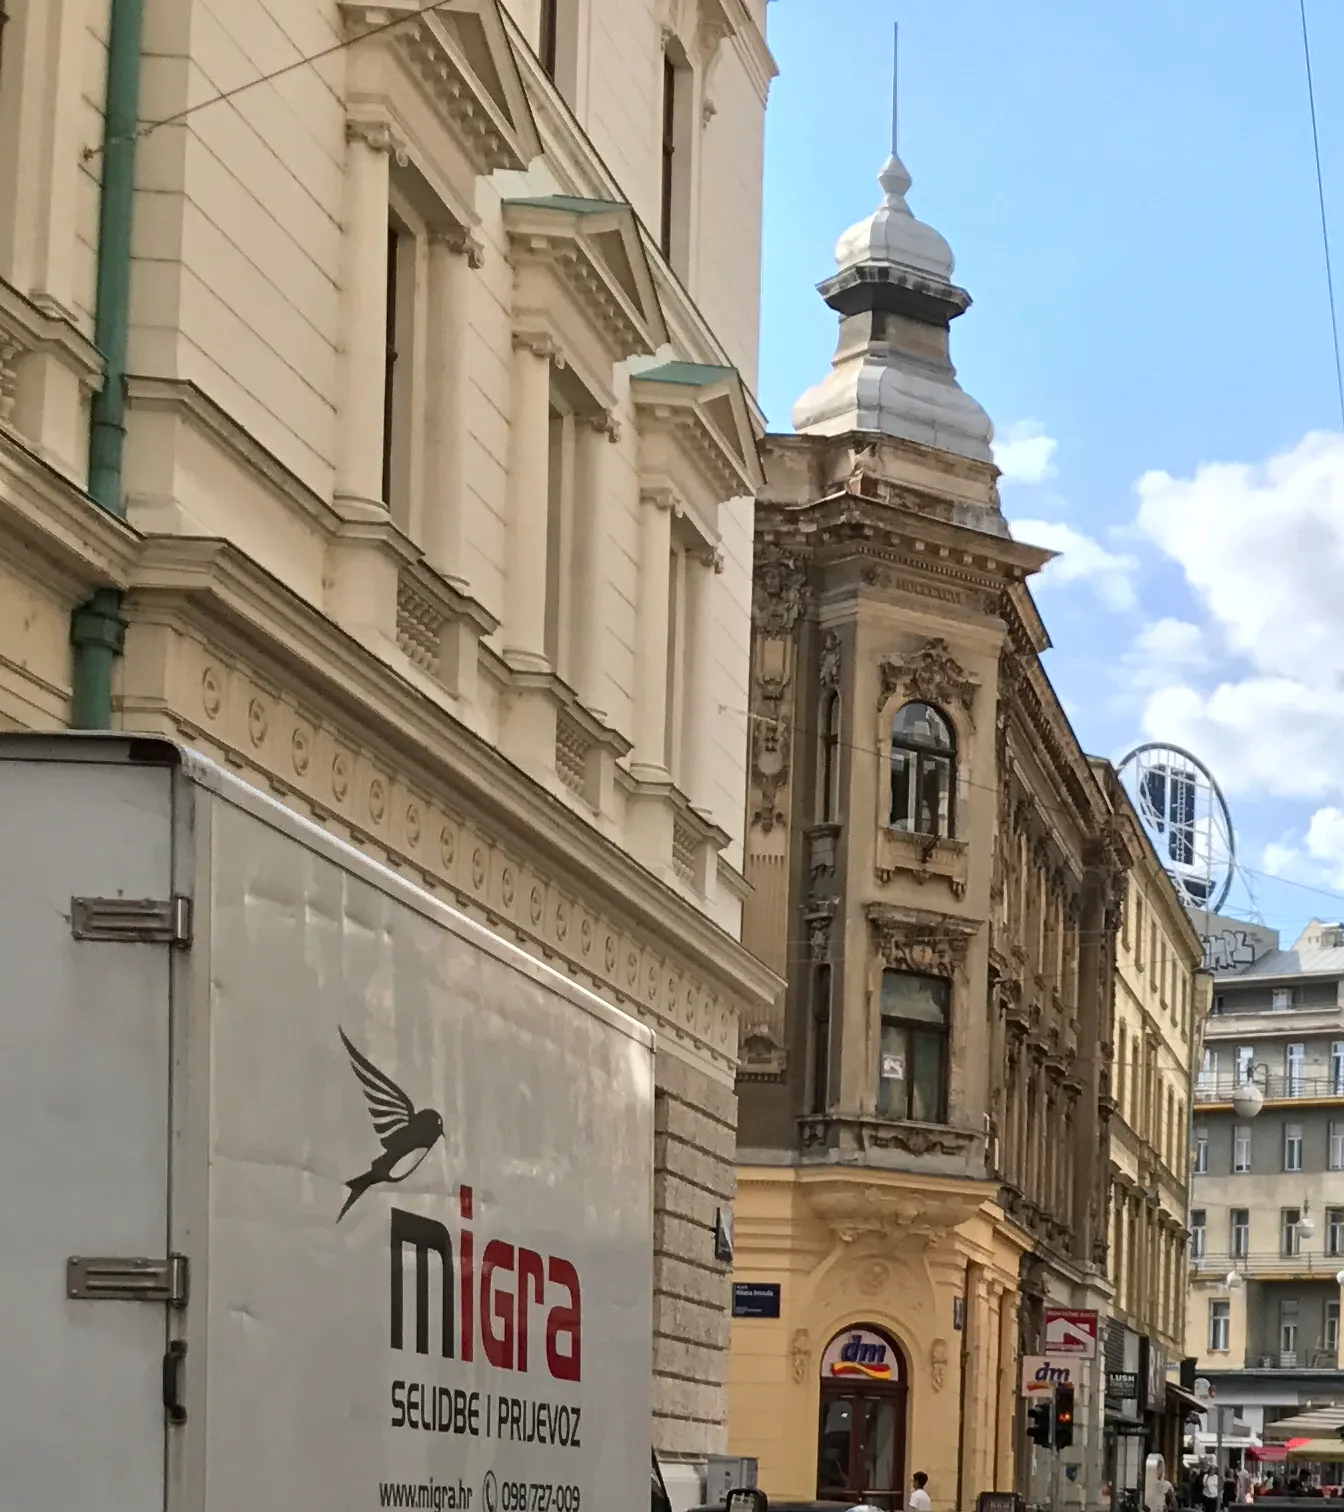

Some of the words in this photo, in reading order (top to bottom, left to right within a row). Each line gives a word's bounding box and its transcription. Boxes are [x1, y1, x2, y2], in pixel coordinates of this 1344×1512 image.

[841, 1335, 887, 1363] dm
[1035, 1361, 1070, 1383] dm
[391, 1380, 480, 1436] SELIDBE
[498, 1395, 581, 1448] PRIJEVOZ
